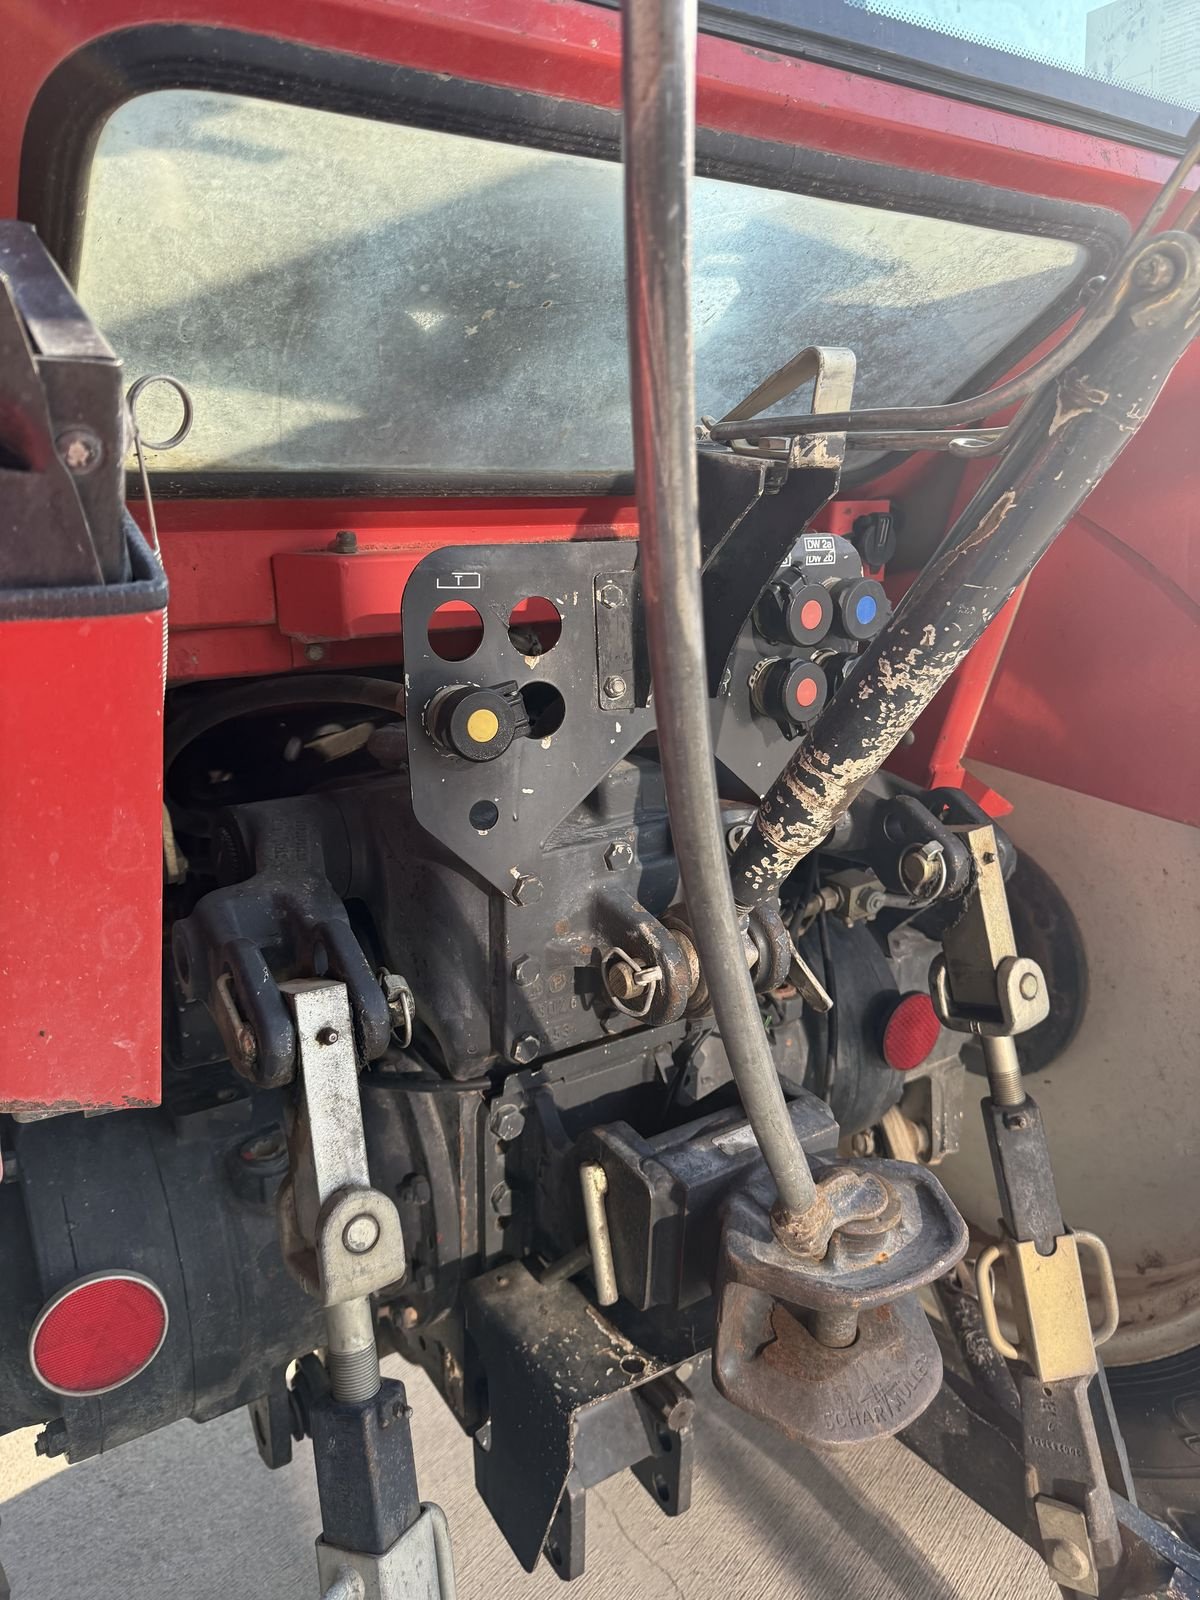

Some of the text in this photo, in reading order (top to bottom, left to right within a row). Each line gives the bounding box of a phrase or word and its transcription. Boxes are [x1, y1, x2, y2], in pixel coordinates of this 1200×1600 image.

[807, 539, 832, 549] DW 2a
[454, 575, 463, 586] T
